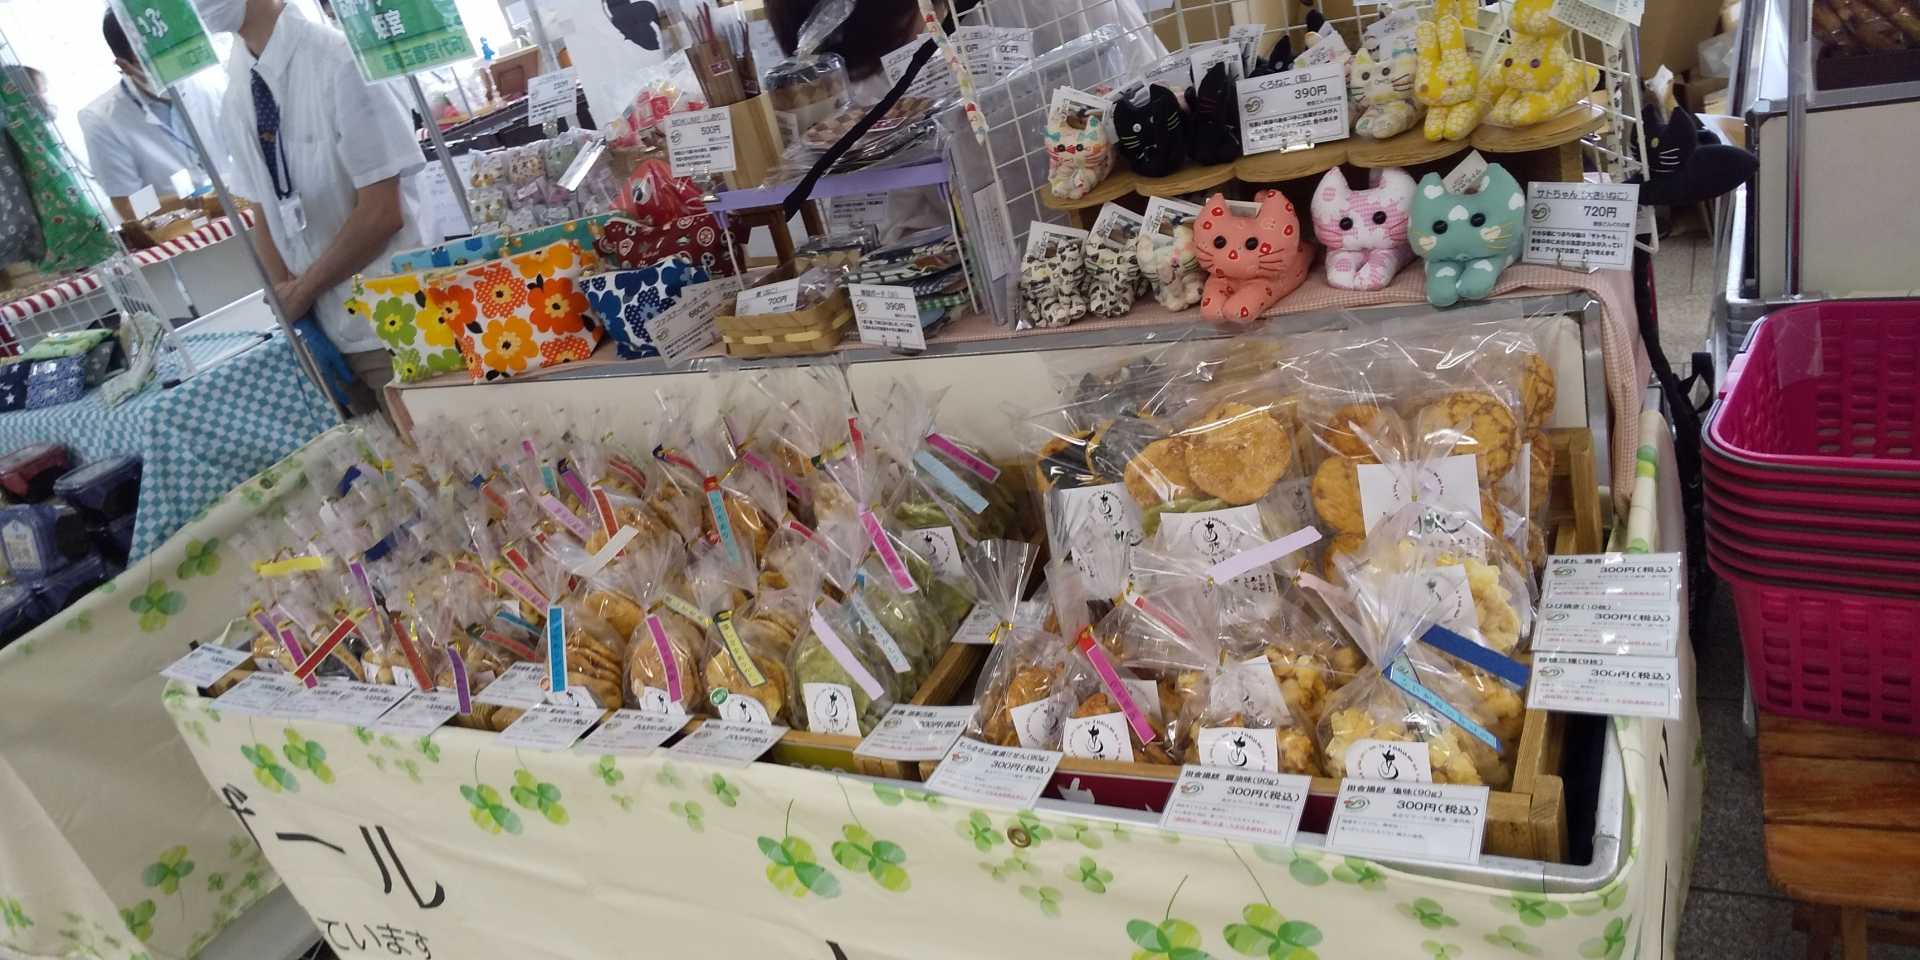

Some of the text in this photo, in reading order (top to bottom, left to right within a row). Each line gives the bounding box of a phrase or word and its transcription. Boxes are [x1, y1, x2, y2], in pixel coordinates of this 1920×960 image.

[371, 9, 406, 40] 姫宮
[1294, 85, 1328, 99] 390円
[1583, 205, 1617, 218] 720円
[1594, 612, 1671, 622] 300円(税込)
[1590, 668, 1672, 681] 300円(税込)
[1227, 786, 1300, 802] 300円(税込)
[1396, 801, 1479, 816] 300円(税込)
